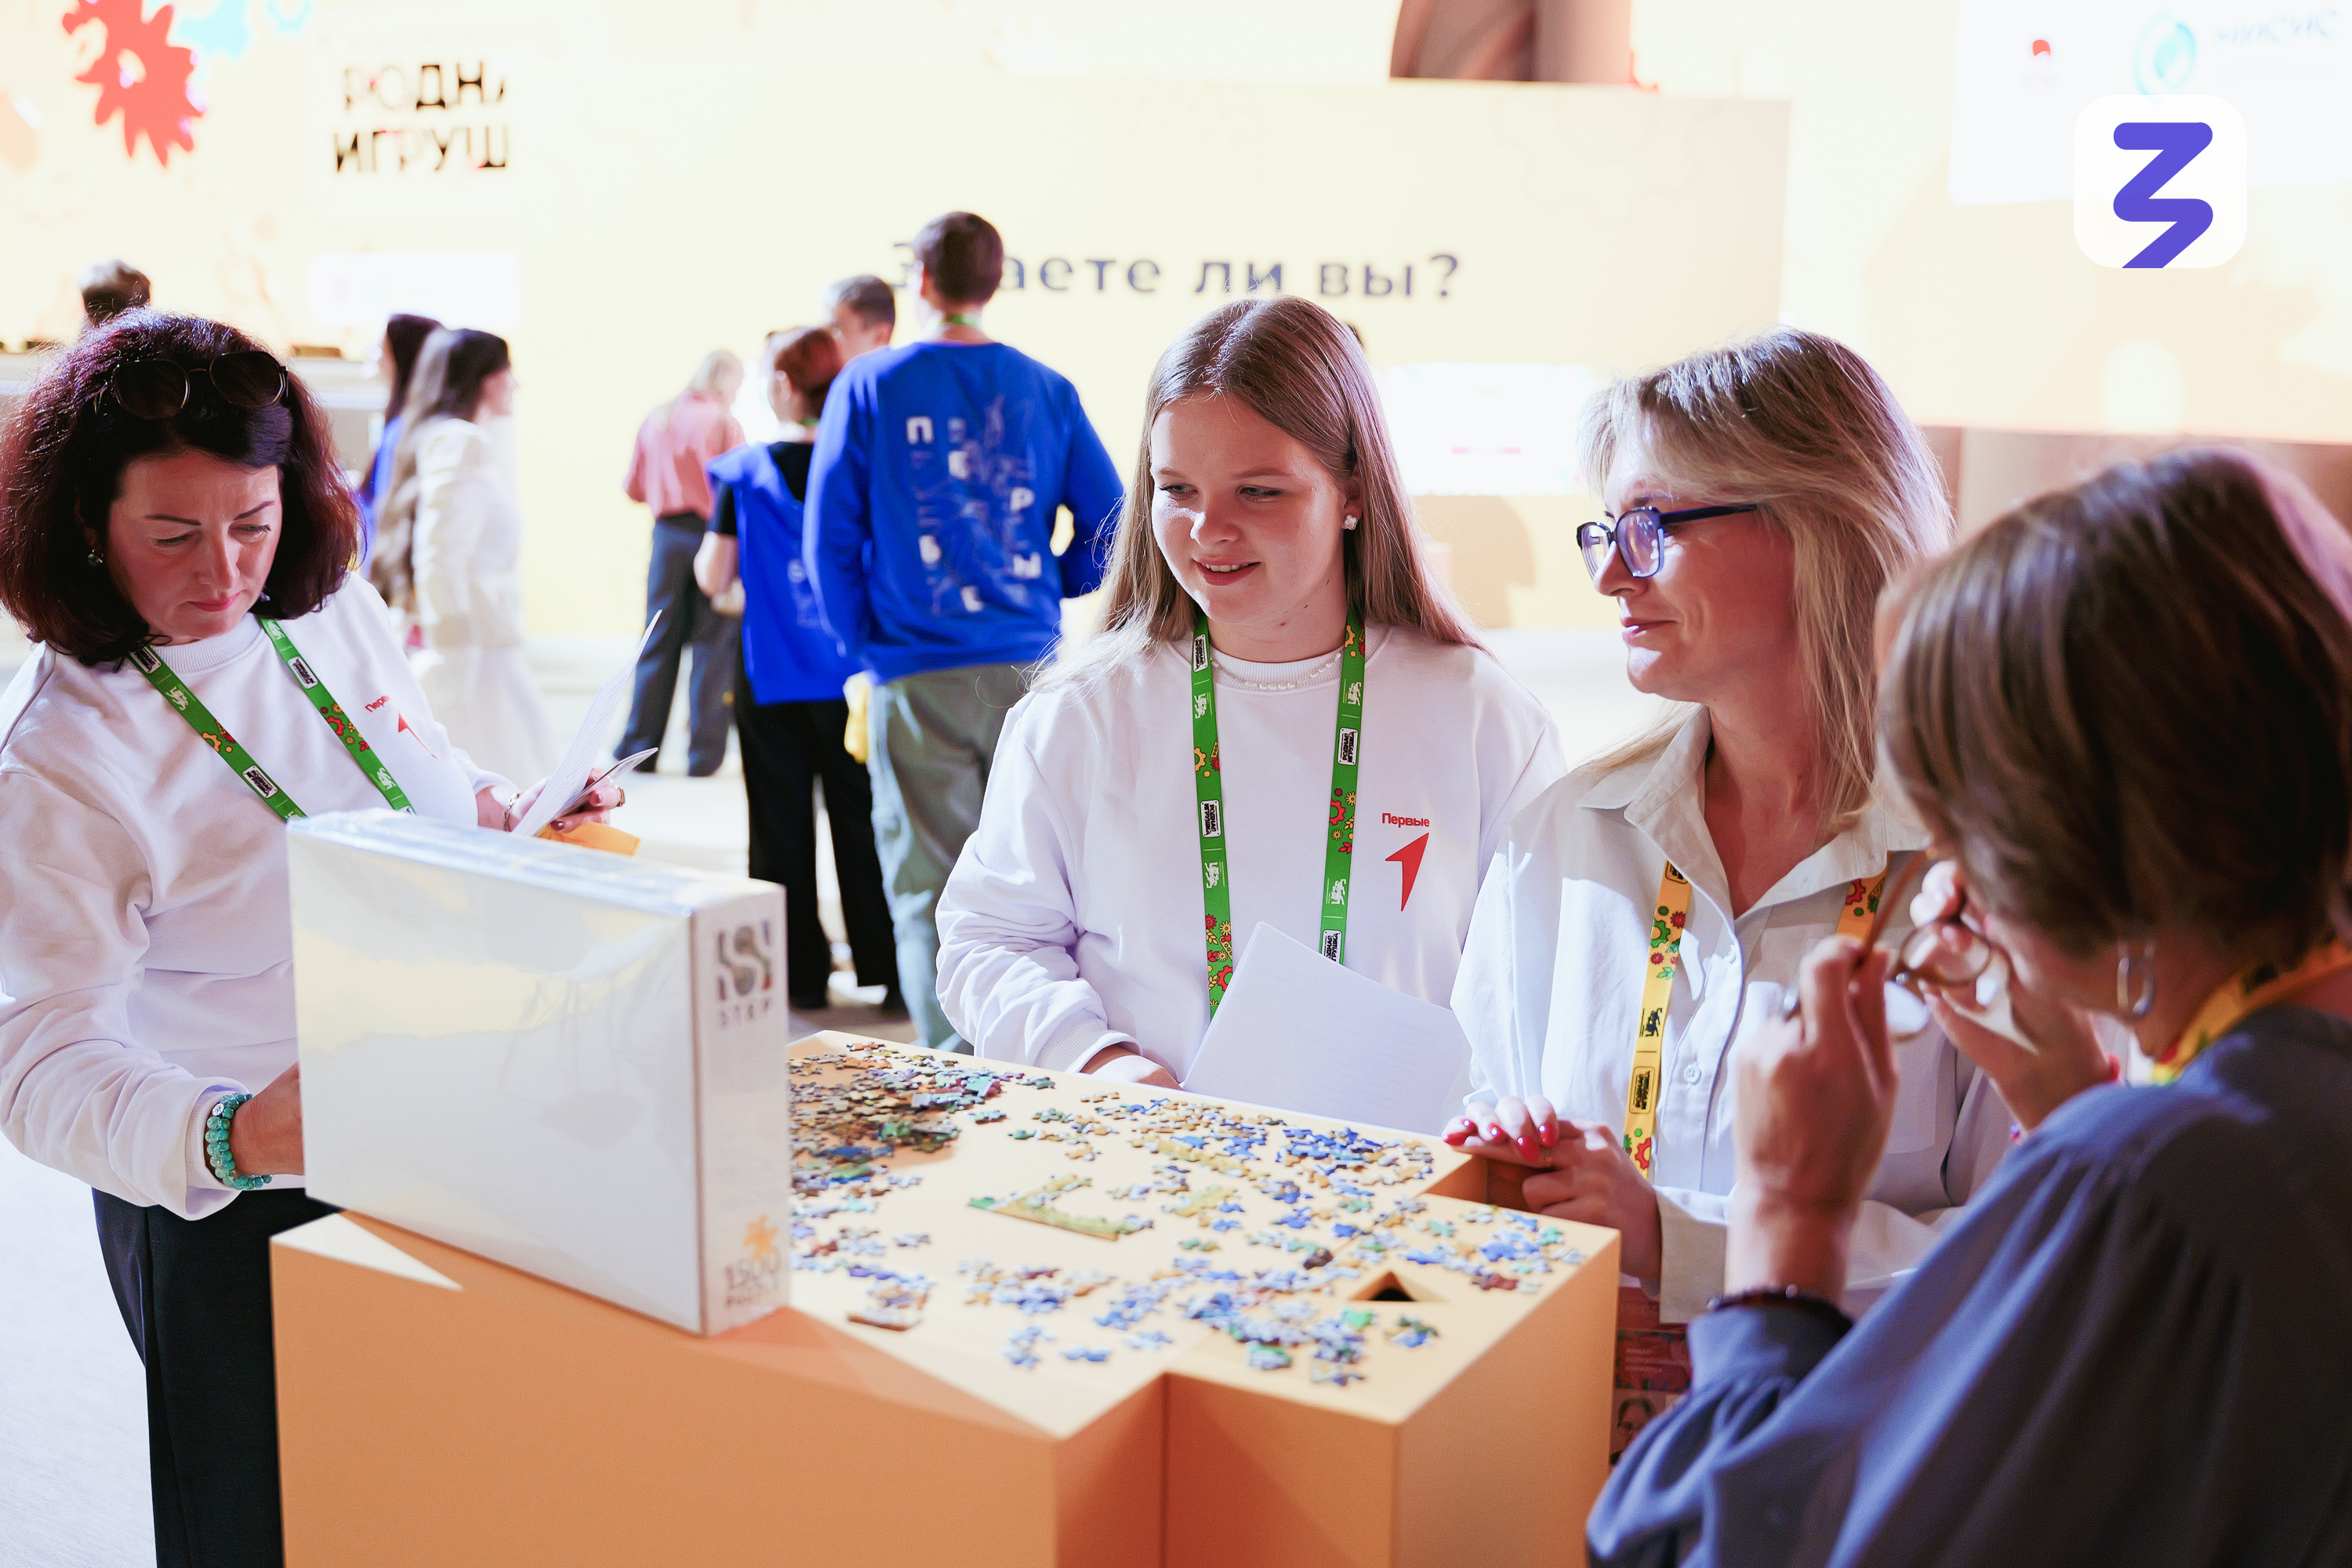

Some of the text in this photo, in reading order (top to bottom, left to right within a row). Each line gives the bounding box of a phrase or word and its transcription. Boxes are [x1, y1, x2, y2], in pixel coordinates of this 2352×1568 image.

[892, 241, 1459, 297] Заете ли вы?
[1382, 812, 1430, 828] Первые
